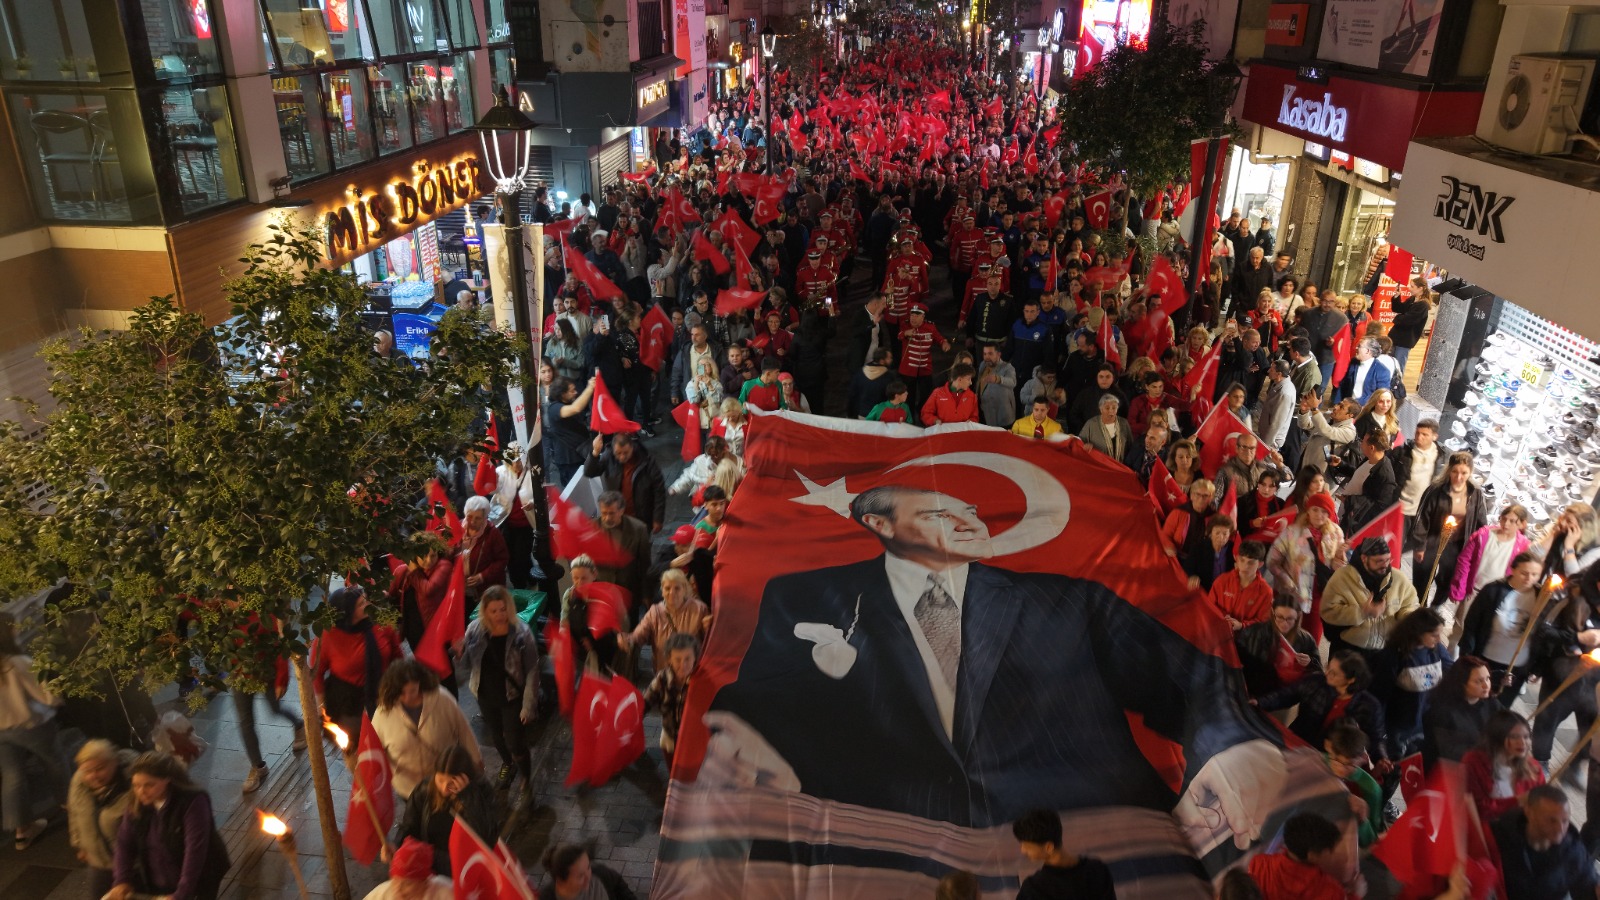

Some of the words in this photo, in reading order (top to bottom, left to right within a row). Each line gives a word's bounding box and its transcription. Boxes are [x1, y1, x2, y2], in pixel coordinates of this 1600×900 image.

[1277, 84, 1348, 142] Kasaba
[325, 187, 387, 259] MİS
[395, 157, 483, 224] DÖNER
[1434, 175, 1516, 243] RENK
[1448, 233, 1463, 250] optik
[1470, 244, 1485, 260] saat
[406, 326, 429, 335] Erikli
[981, 302, 991, 332] ZABITA
[1521, 369, 1537, 384] 600
